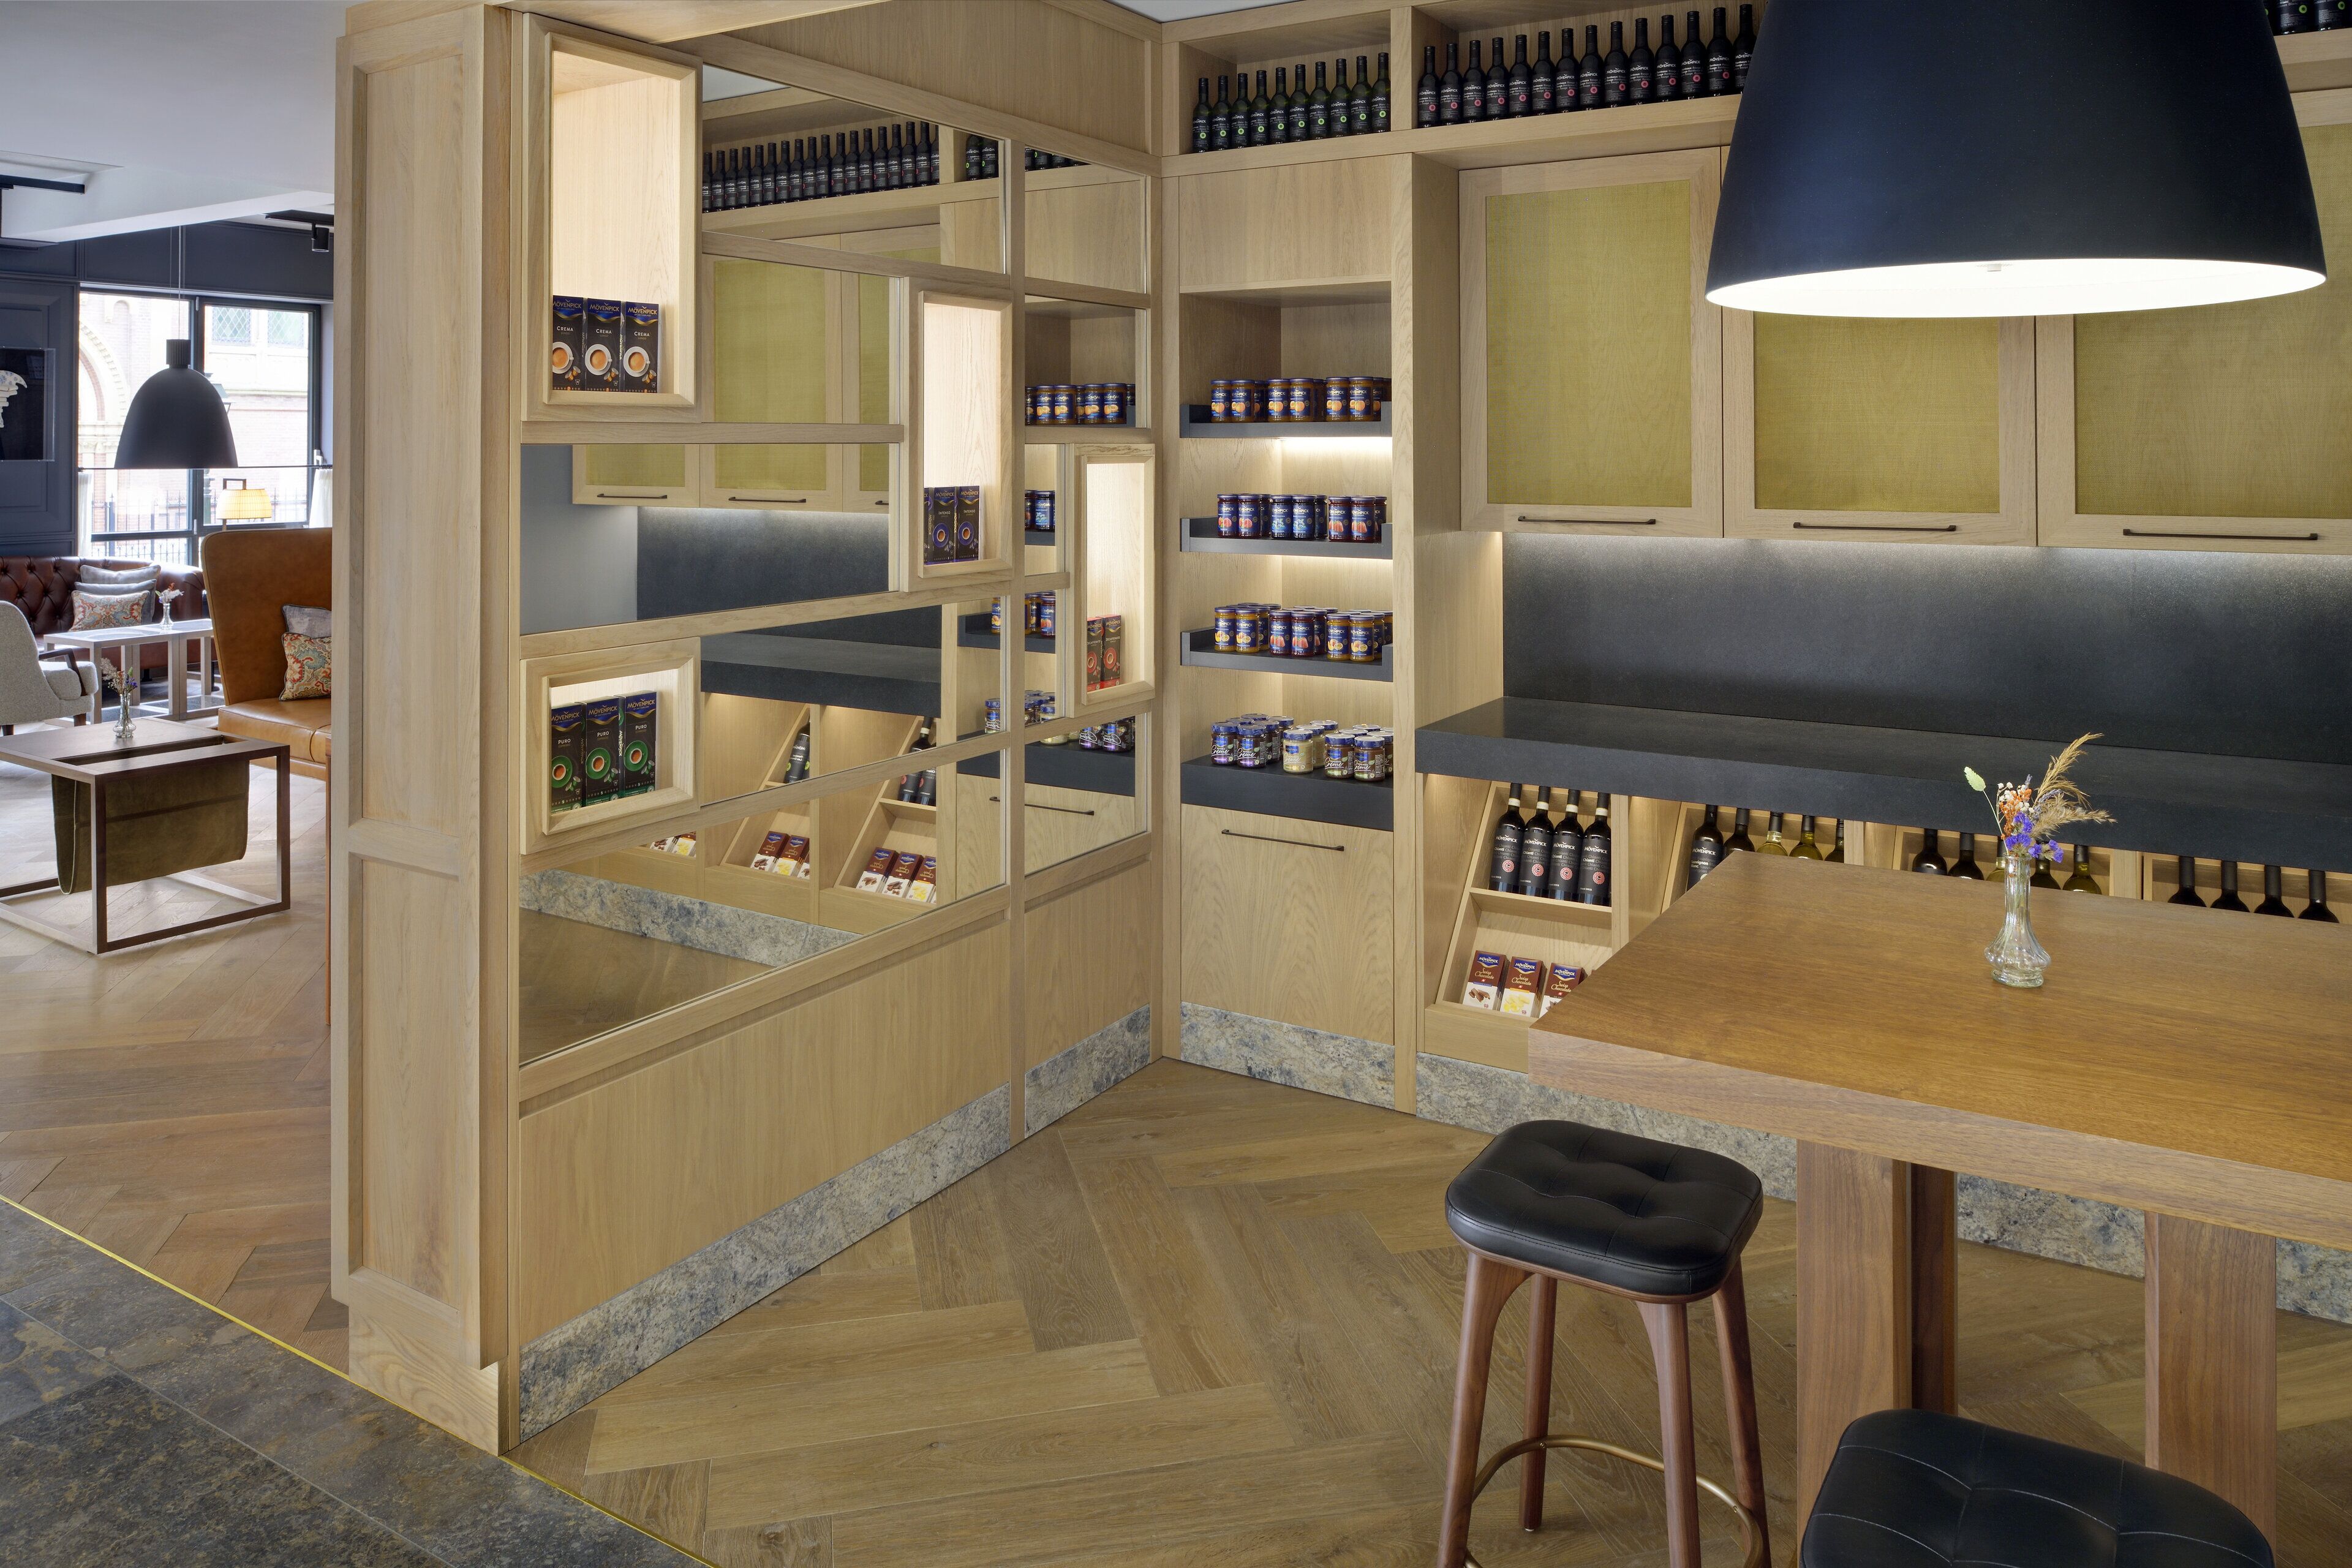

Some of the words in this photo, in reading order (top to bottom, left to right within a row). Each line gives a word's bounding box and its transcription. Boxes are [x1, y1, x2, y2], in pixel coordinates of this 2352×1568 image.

[553, 300, 582, 309] MÖVENPICK
[590, 303, 619, 312] MÖVENPICK
[628, 306, 657, 315] MÖVENPICK
[627, 699, 655, 709] MÖVENPICK
[589, 705, 617, 715] MÖVENPICK
[551, 712, 580, 722] MÖVENPICK
[1212, 745, 1229, 753] Creme
[1237, 748, 1256, 758] Creme
[1325, 757, 1344, 767] Creme
[1475, 971, 1494, 979] Chocolate
[1512, 977, 1531, 986] Chocolate
[1551, 984, 1572, 992] Chocolate
